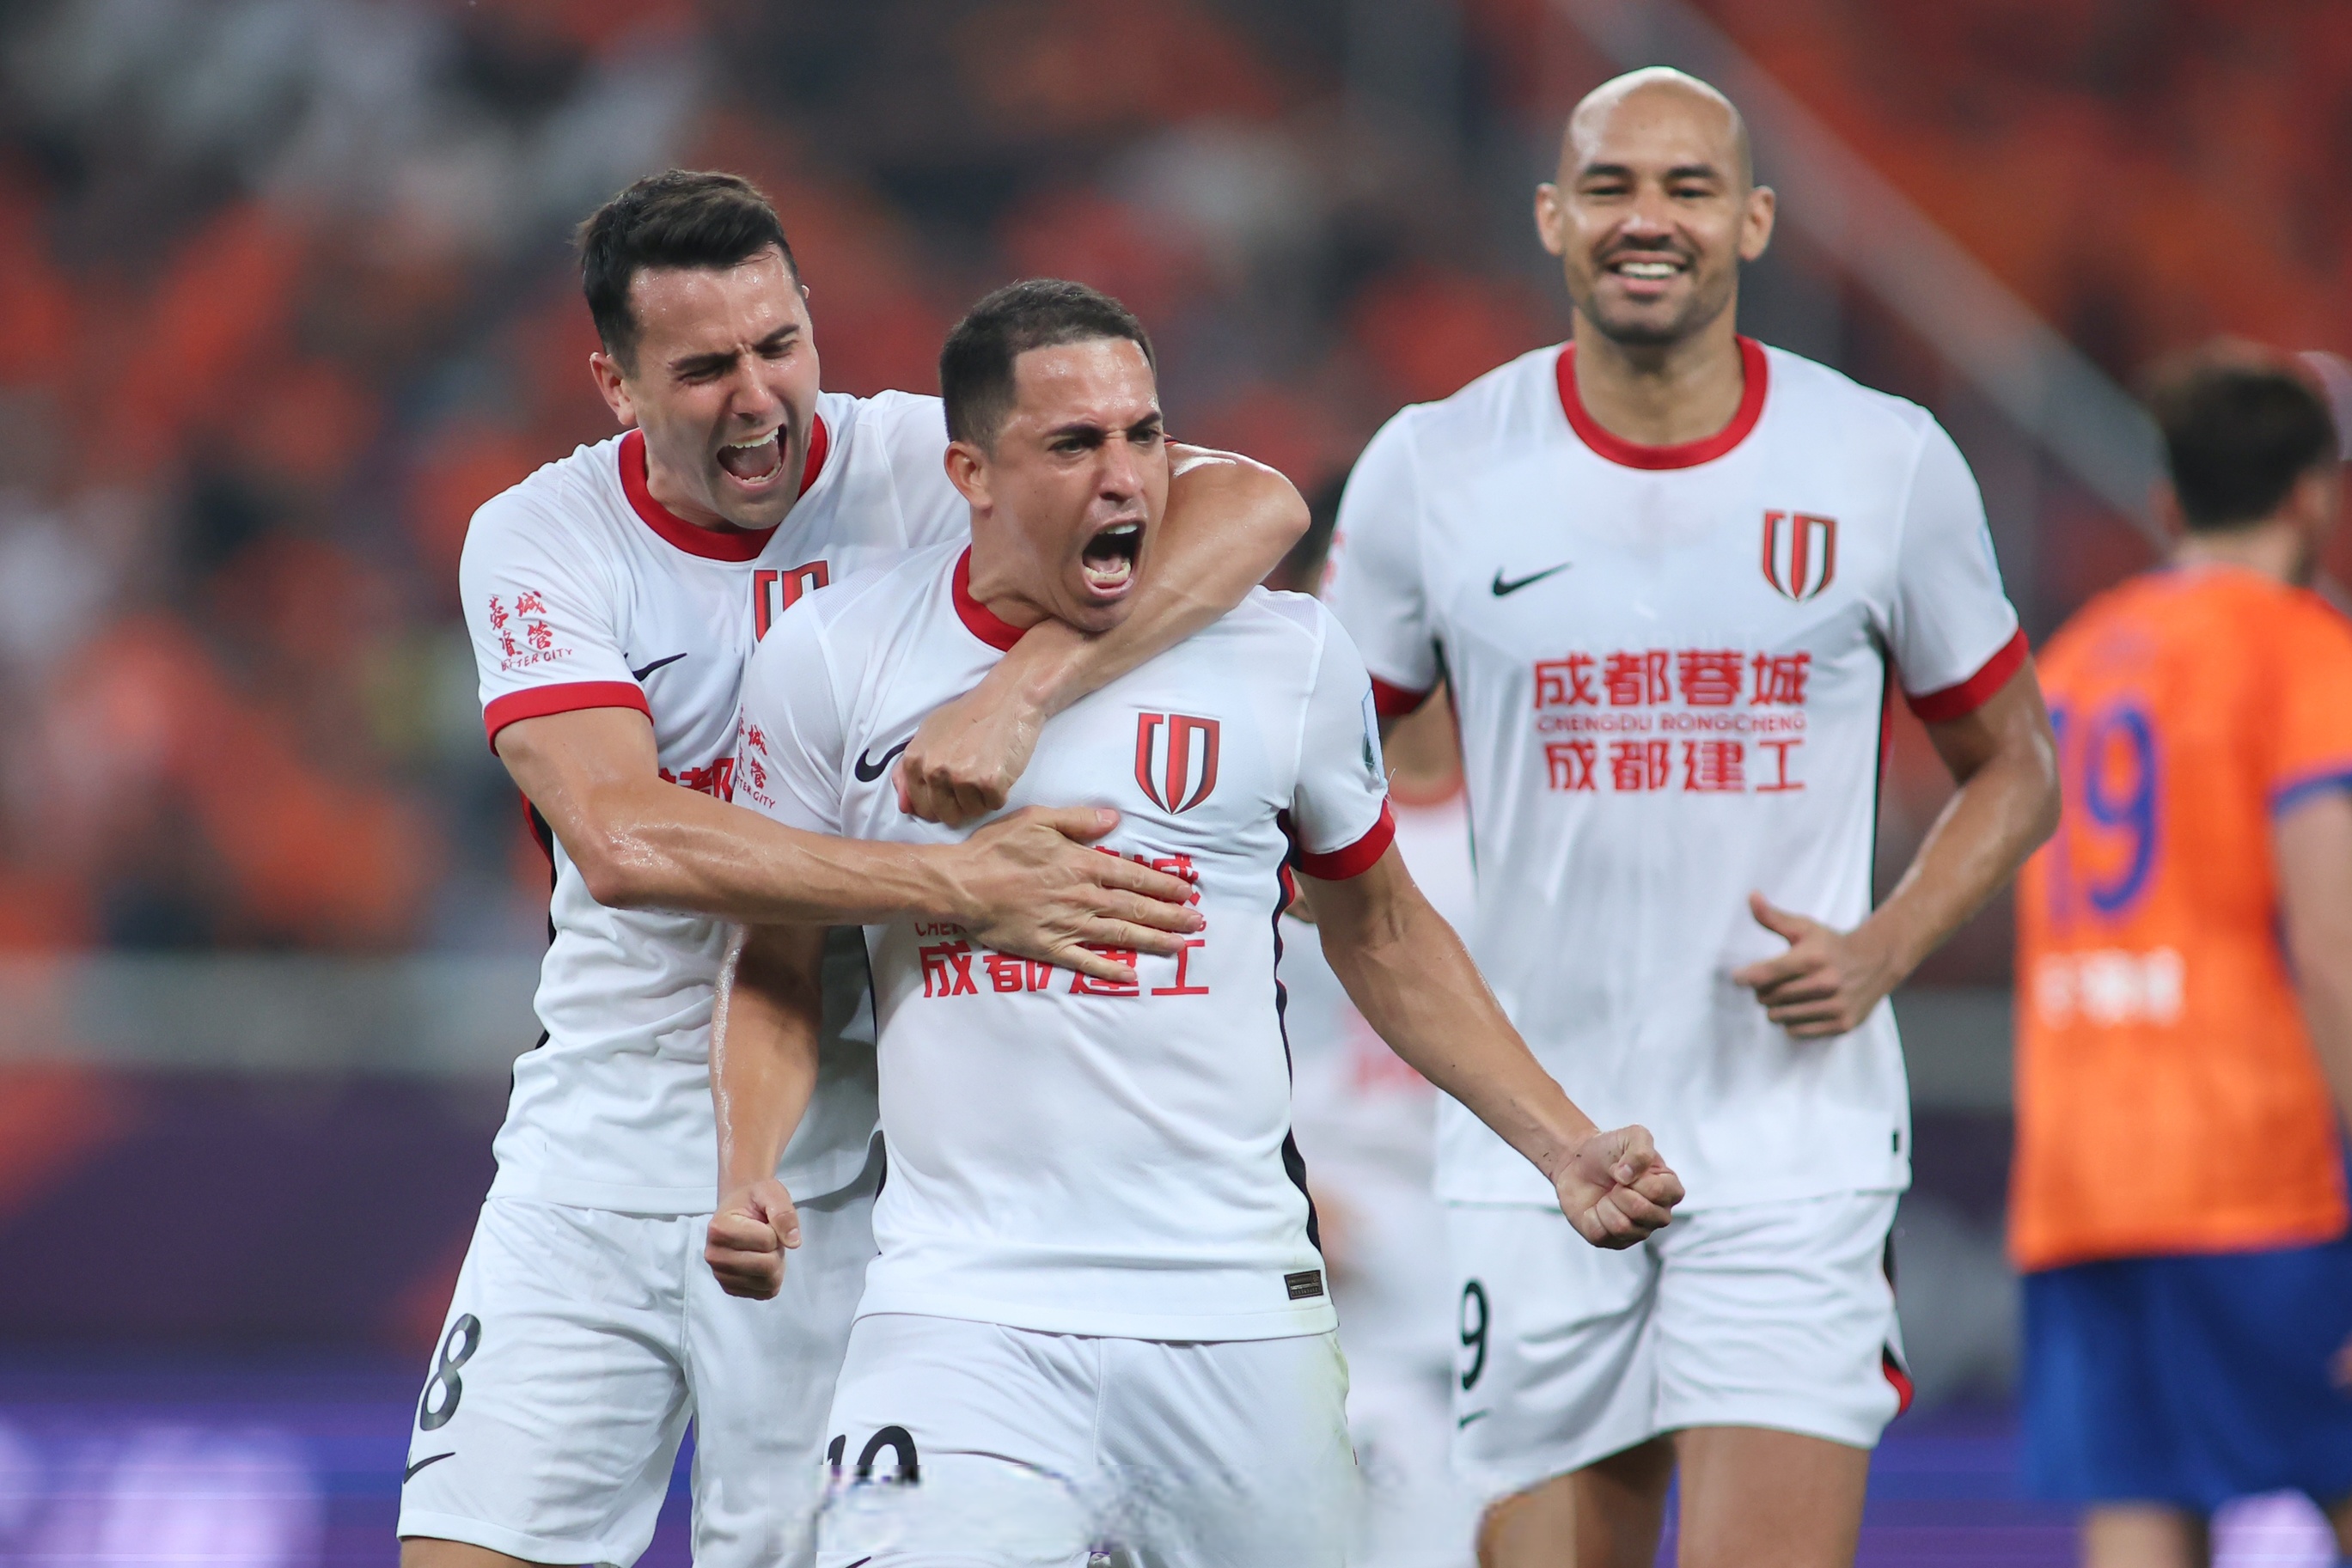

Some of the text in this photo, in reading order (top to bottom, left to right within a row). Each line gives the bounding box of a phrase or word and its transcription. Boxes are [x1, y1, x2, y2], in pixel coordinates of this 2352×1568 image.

[543, 648, 572, 662] CITY
[1535, 650, 1811, 708] 成都蓉城
[1537, 712, 1806, 734] CHENGDU RONGCHENG
[1545, 739, 1805, 792] 成都建工
[753, 790, 775, 809] CITY
[1459, 1279, 1489, 1390] 9
[419, 1313, 481, 1431] 8
